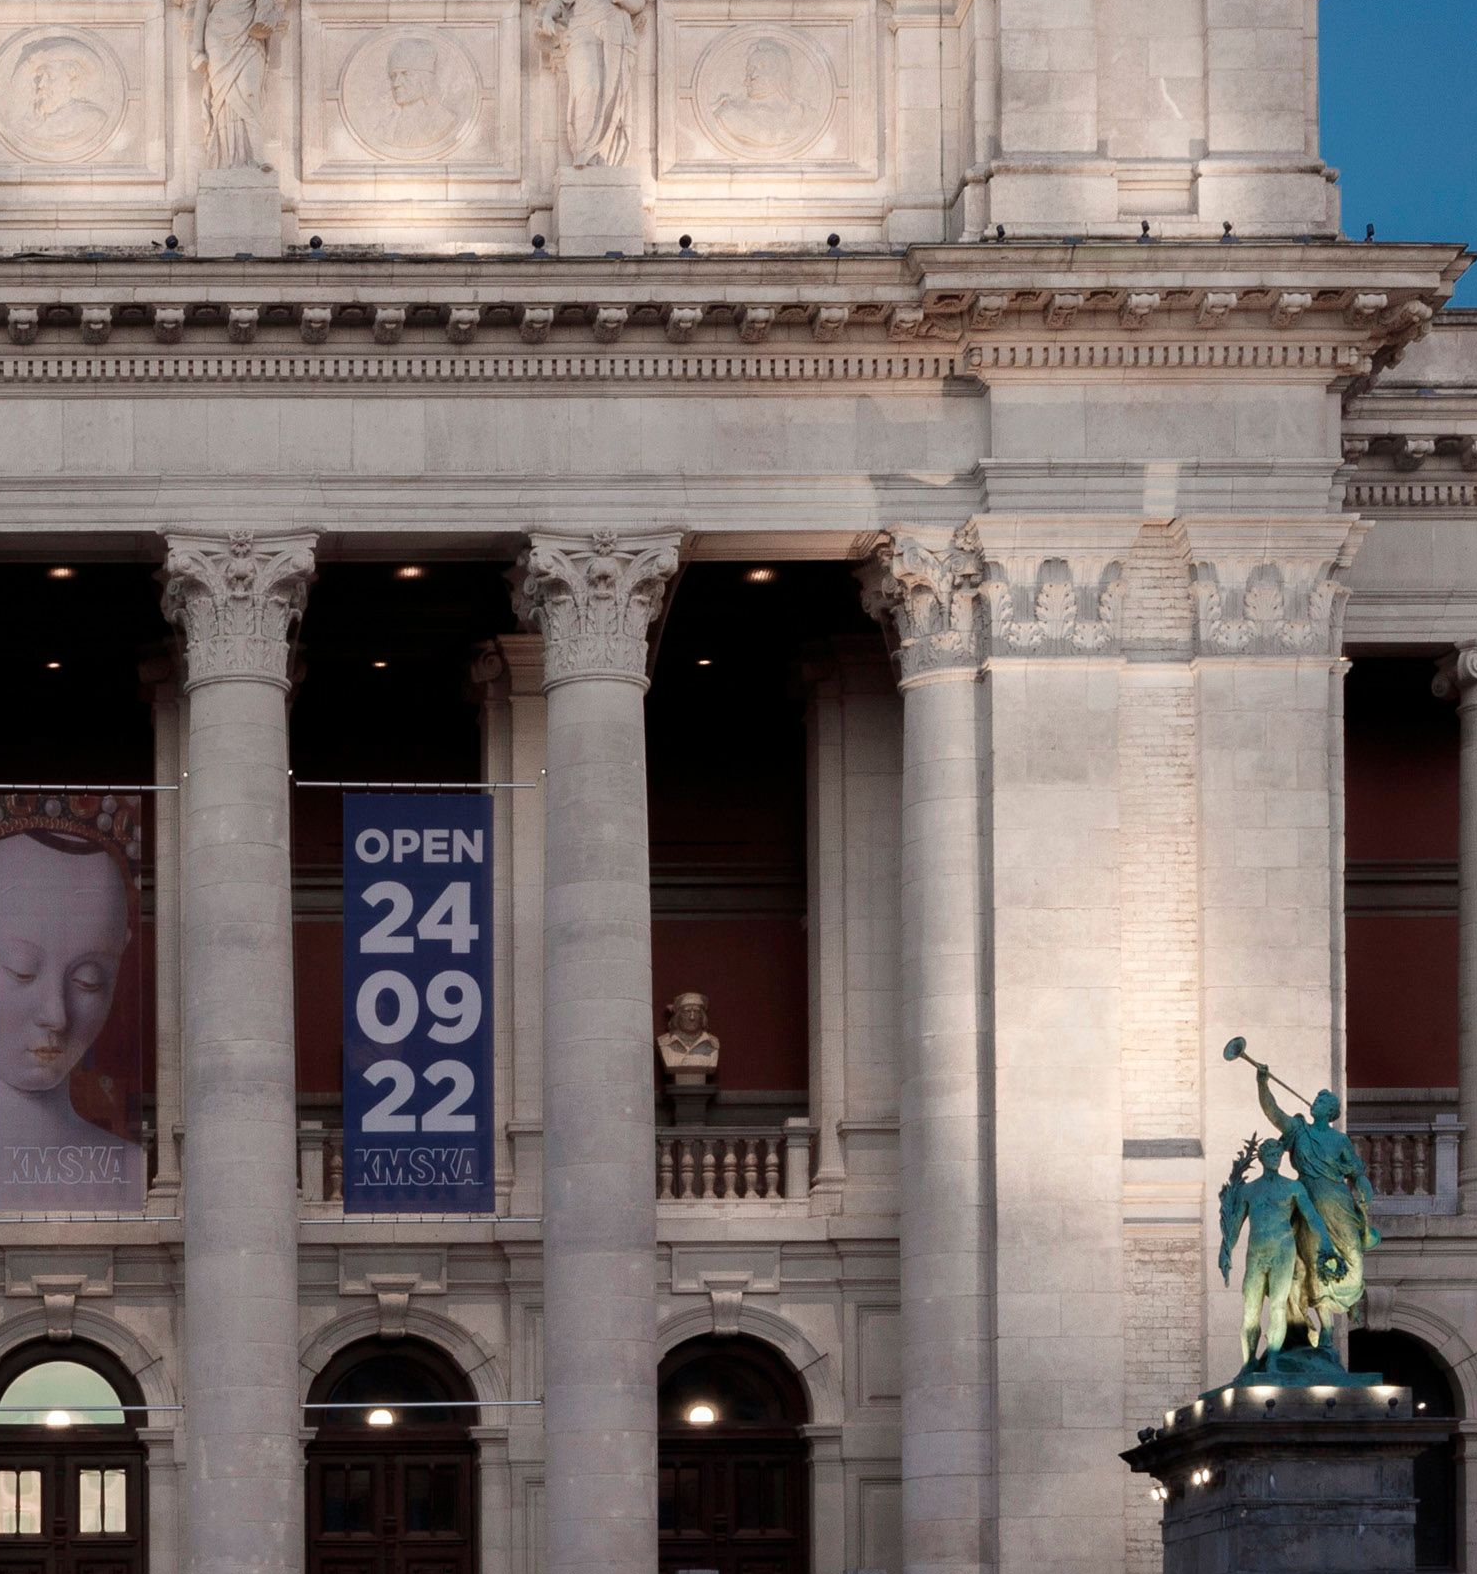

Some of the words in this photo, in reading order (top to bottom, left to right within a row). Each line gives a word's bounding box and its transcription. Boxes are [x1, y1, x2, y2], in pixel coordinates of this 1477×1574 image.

[355, 828, 483, 863] OPEN
[360, 880, 479, 954] 24
[356, 969, 482, 1044] 09
[361, 1059, 476, 1132] 22
[4, 1146, 130, 1184] KMSKA
[354, 1147, 483, 1186] KMSKA
